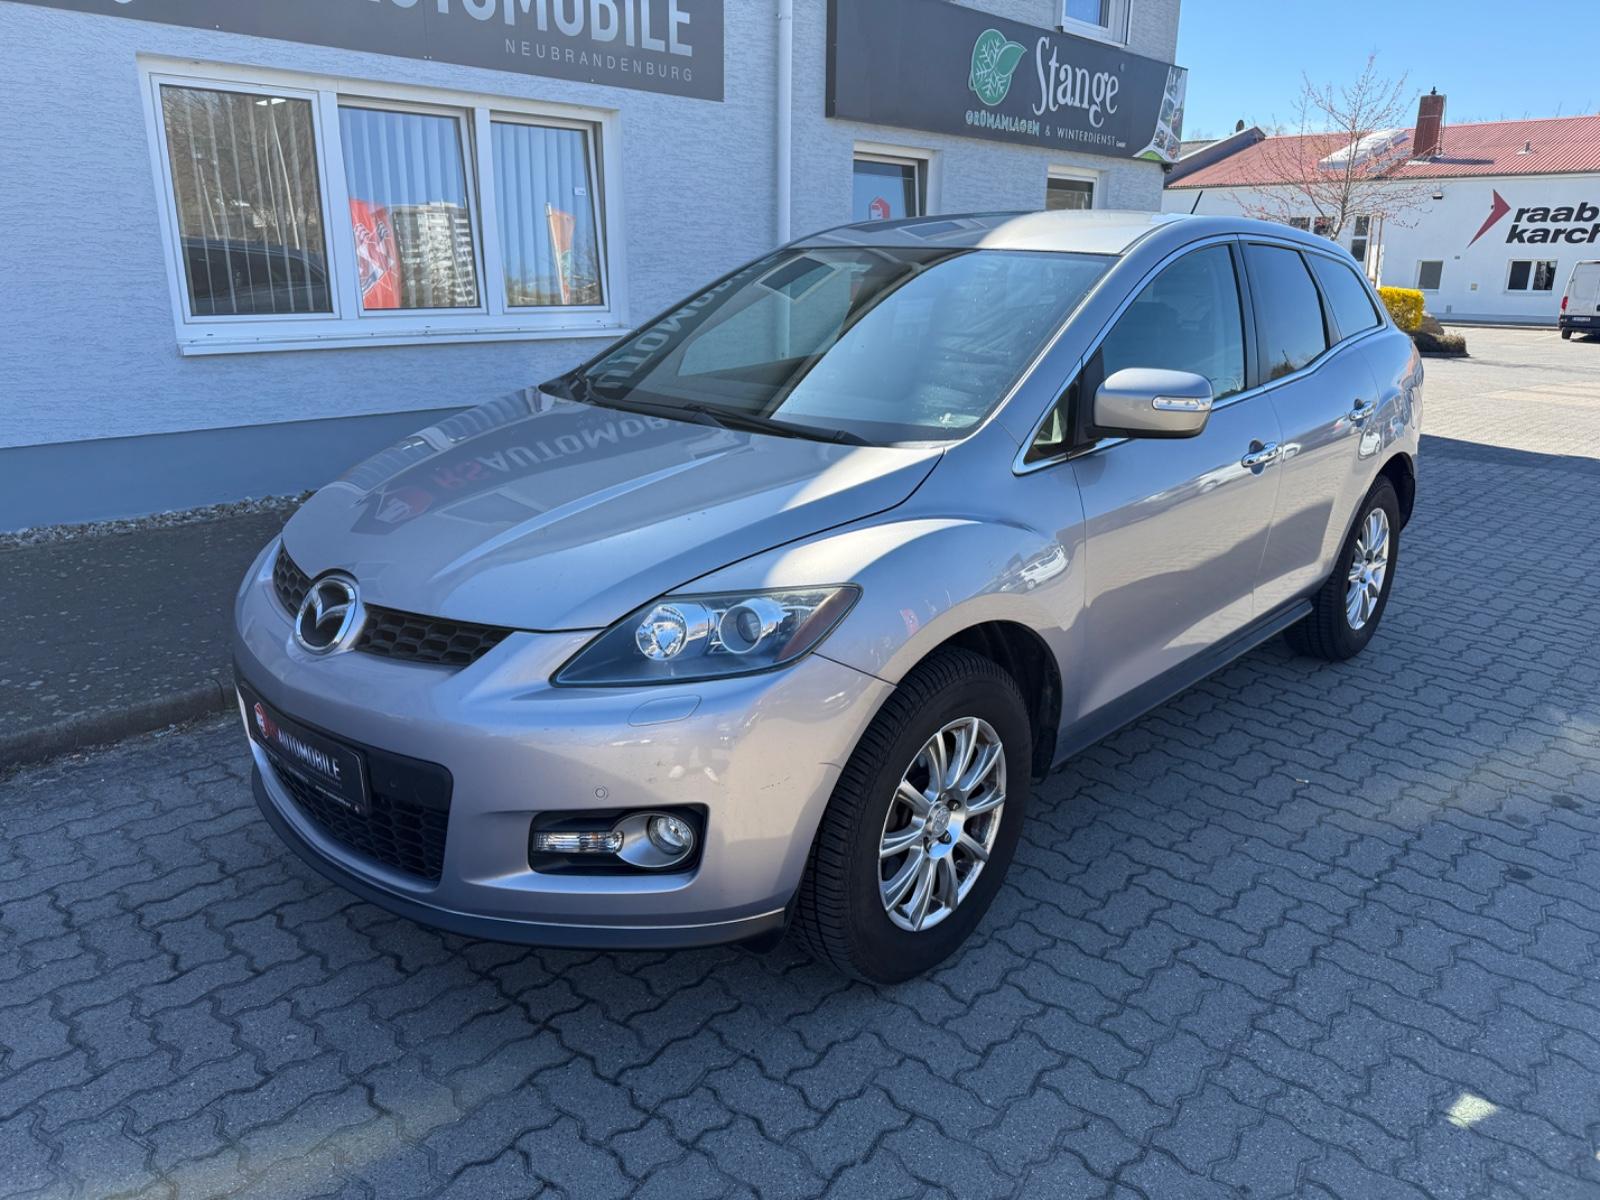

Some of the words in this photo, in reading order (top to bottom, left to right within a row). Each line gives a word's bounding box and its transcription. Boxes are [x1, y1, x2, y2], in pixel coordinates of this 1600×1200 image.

[368, 0, 693, 57] OBILE
[505, 38, 692, 82] NEUBRANDENBURG
[1032, 36, 1119, 128] Stange
[1057, 127, 1116, 146] WINTERDIENST
[1514, 202, 1600, 223] raab
